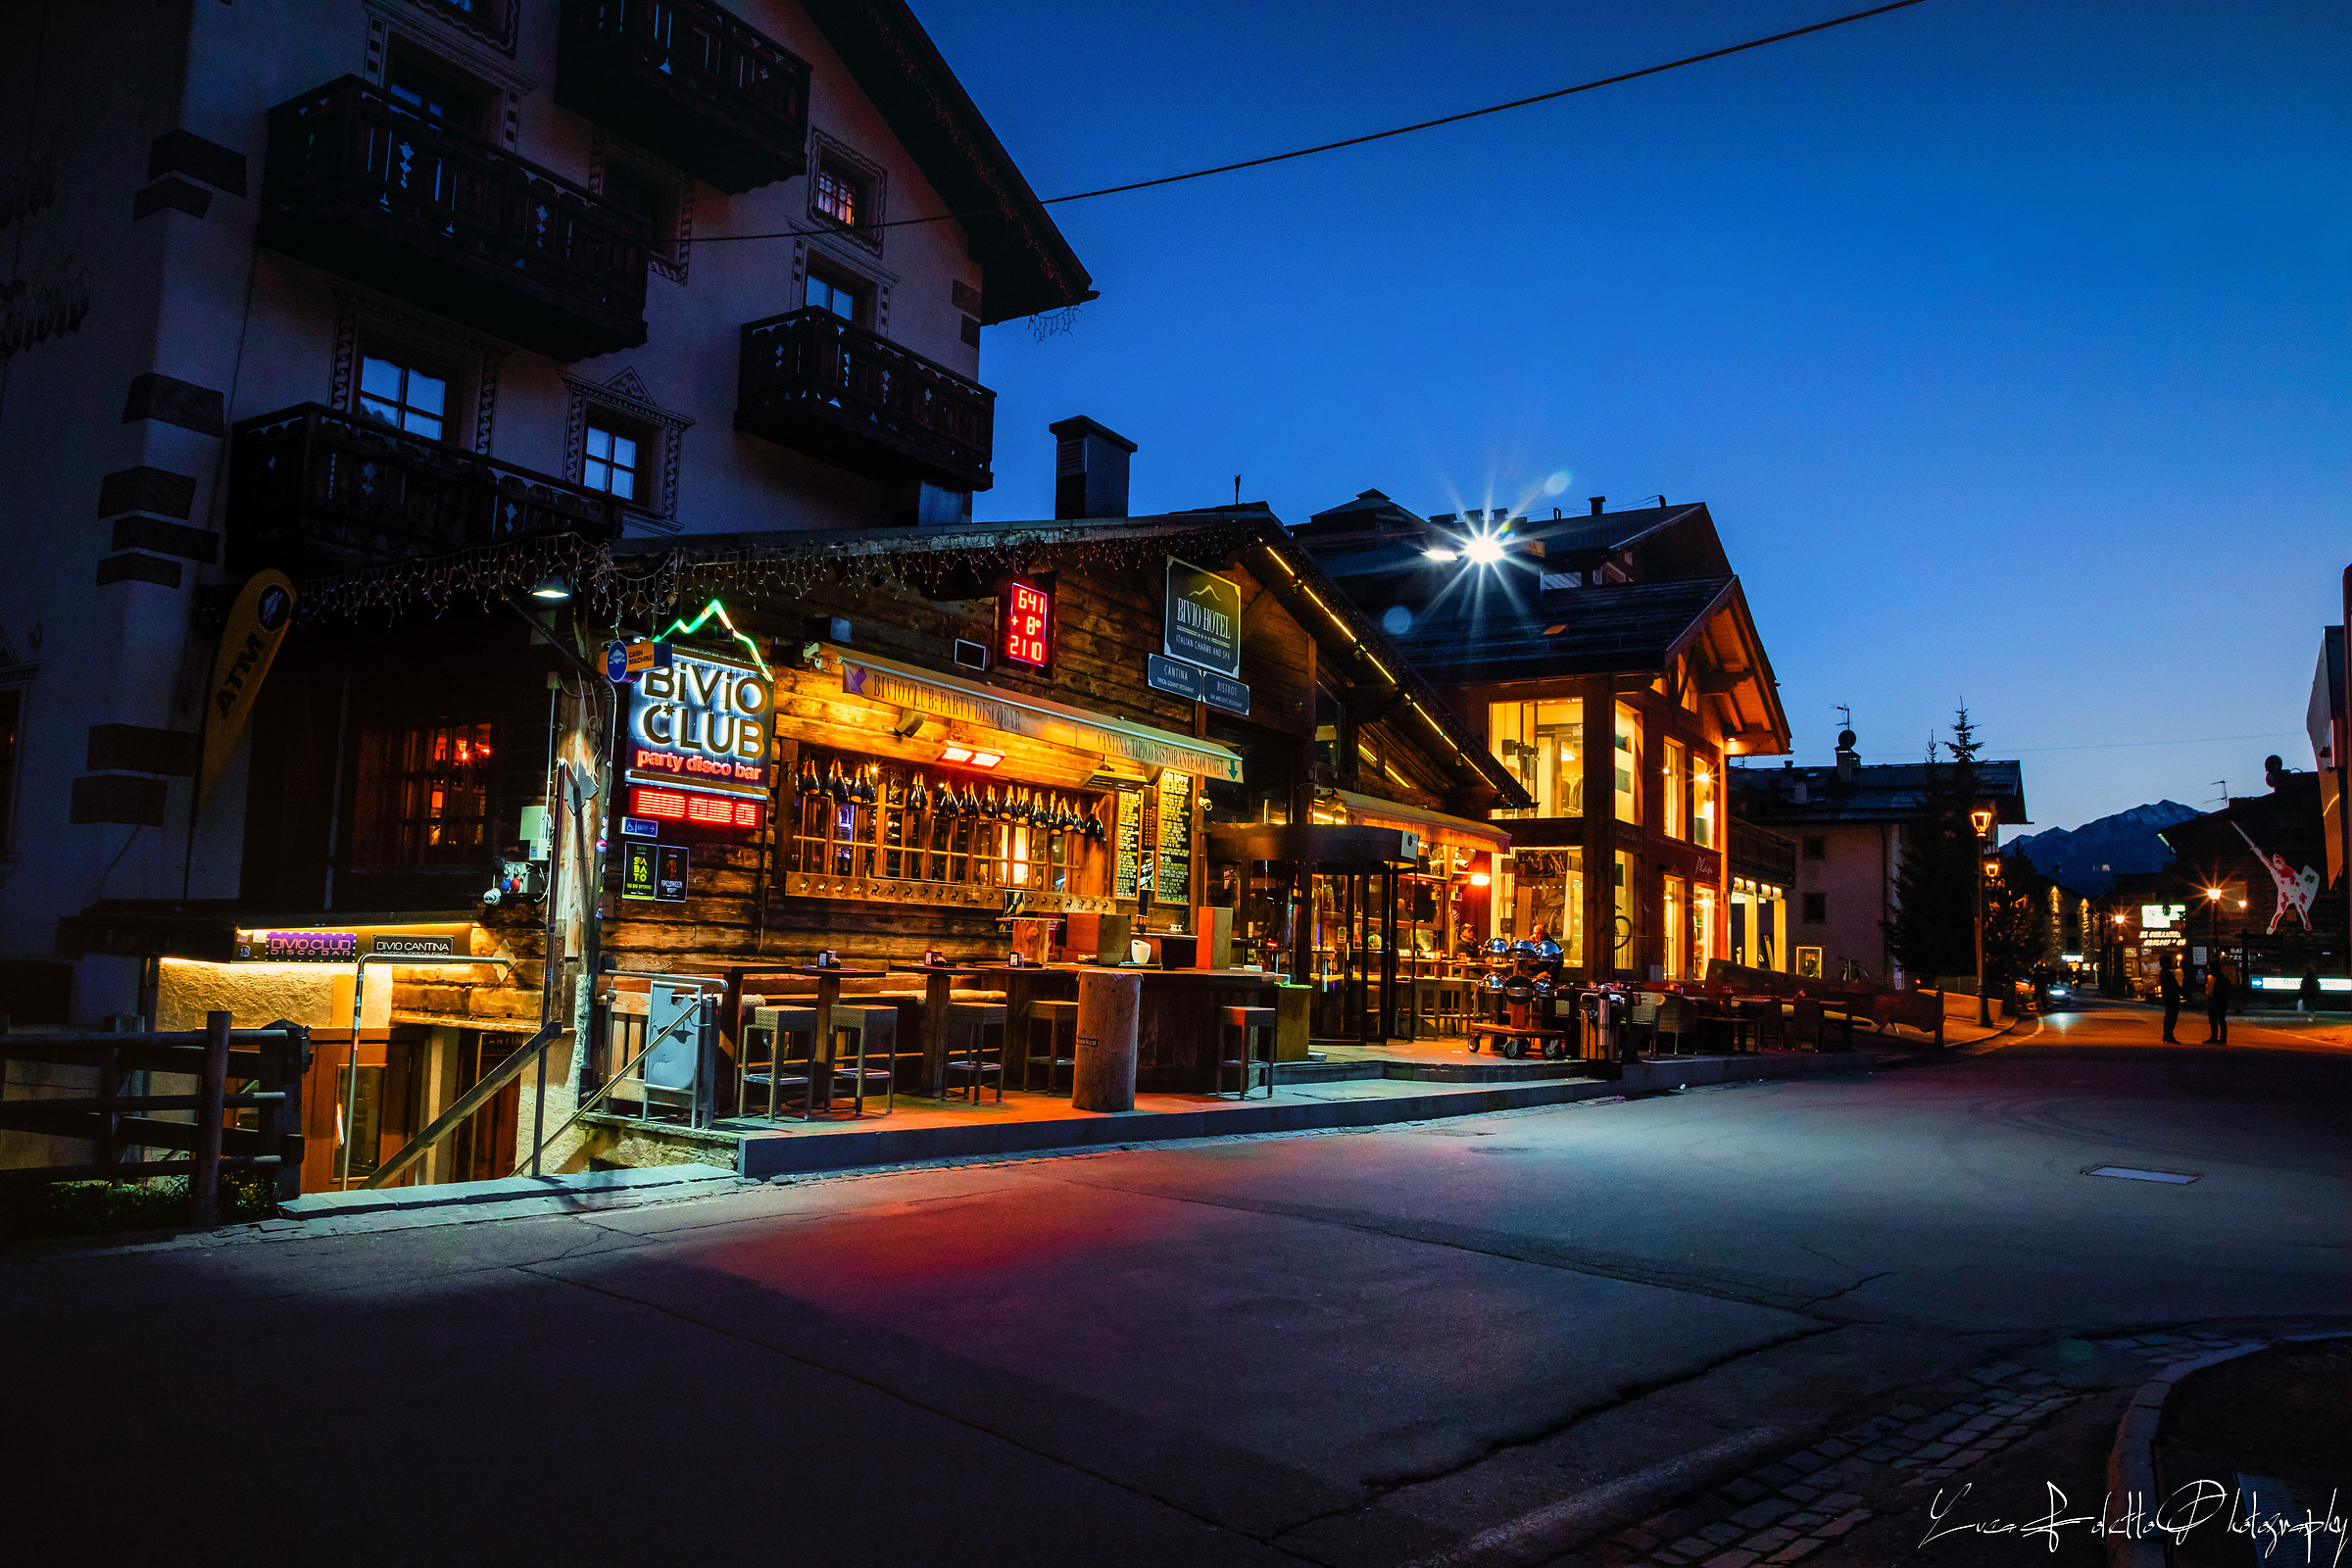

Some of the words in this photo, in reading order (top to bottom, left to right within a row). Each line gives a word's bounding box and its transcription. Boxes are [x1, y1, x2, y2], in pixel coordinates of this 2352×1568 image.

[1177, 598, 1201, 628] BIVIO
[1203, 607, 1231, 640] HOTEL
[628, 655, 653, 665] MACHINE
[1176, 634, 1194, 648] ITALIAN
[1195, 640, 1212, 654] CHARME
[1212, 648, 1222, 658] AND
[216, 632, 266, 719] ATM
[1163, 664, 1189, 682] CANTINA
[874, 674, 906, 703] BIVIO
[907, 683, 937, 710] CLUB:
[941, 691, 973, 718] PARTY
[1217, 681, 1238, 696] BISTROT
[644, 704, 764, 760] CLUB
[637, 750, 684, 772] party
[686, 755, 731, 775] disco
[734, 761, 761, 780] bar
[1131, 739, 1153, 760] TIPICO
[1154, 744, 1195, 770] RISTORANTE
[1196, 754, 1224, 776] GOURMET
[404, 942, 450, 952] CANTINA
